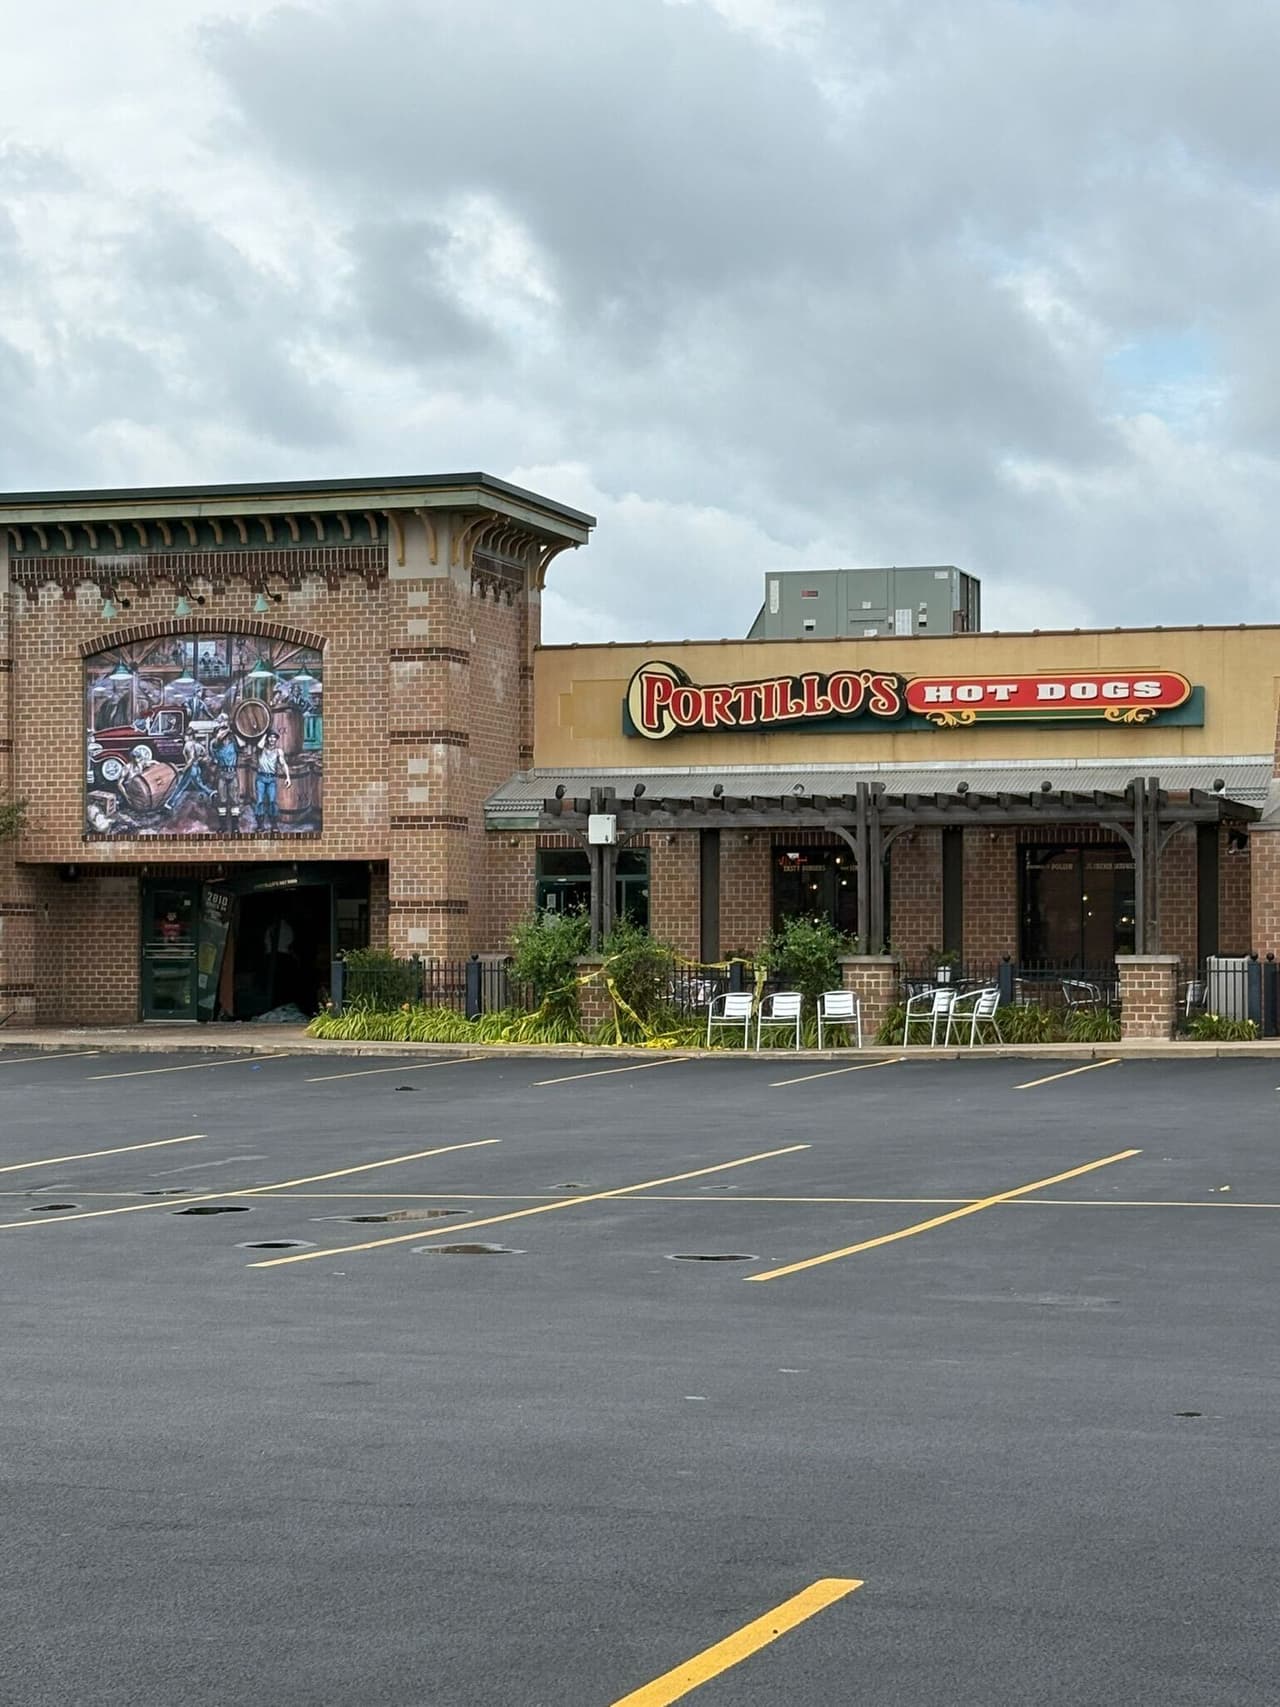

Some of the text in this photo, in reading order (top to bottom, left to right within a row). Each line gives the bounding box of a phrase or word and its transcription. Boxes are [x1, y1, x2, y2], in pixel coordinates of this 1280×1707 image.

[639, 671, 901, 729] PORTILLO'S
[924, 681, 1162, 703] HOT DOGS
